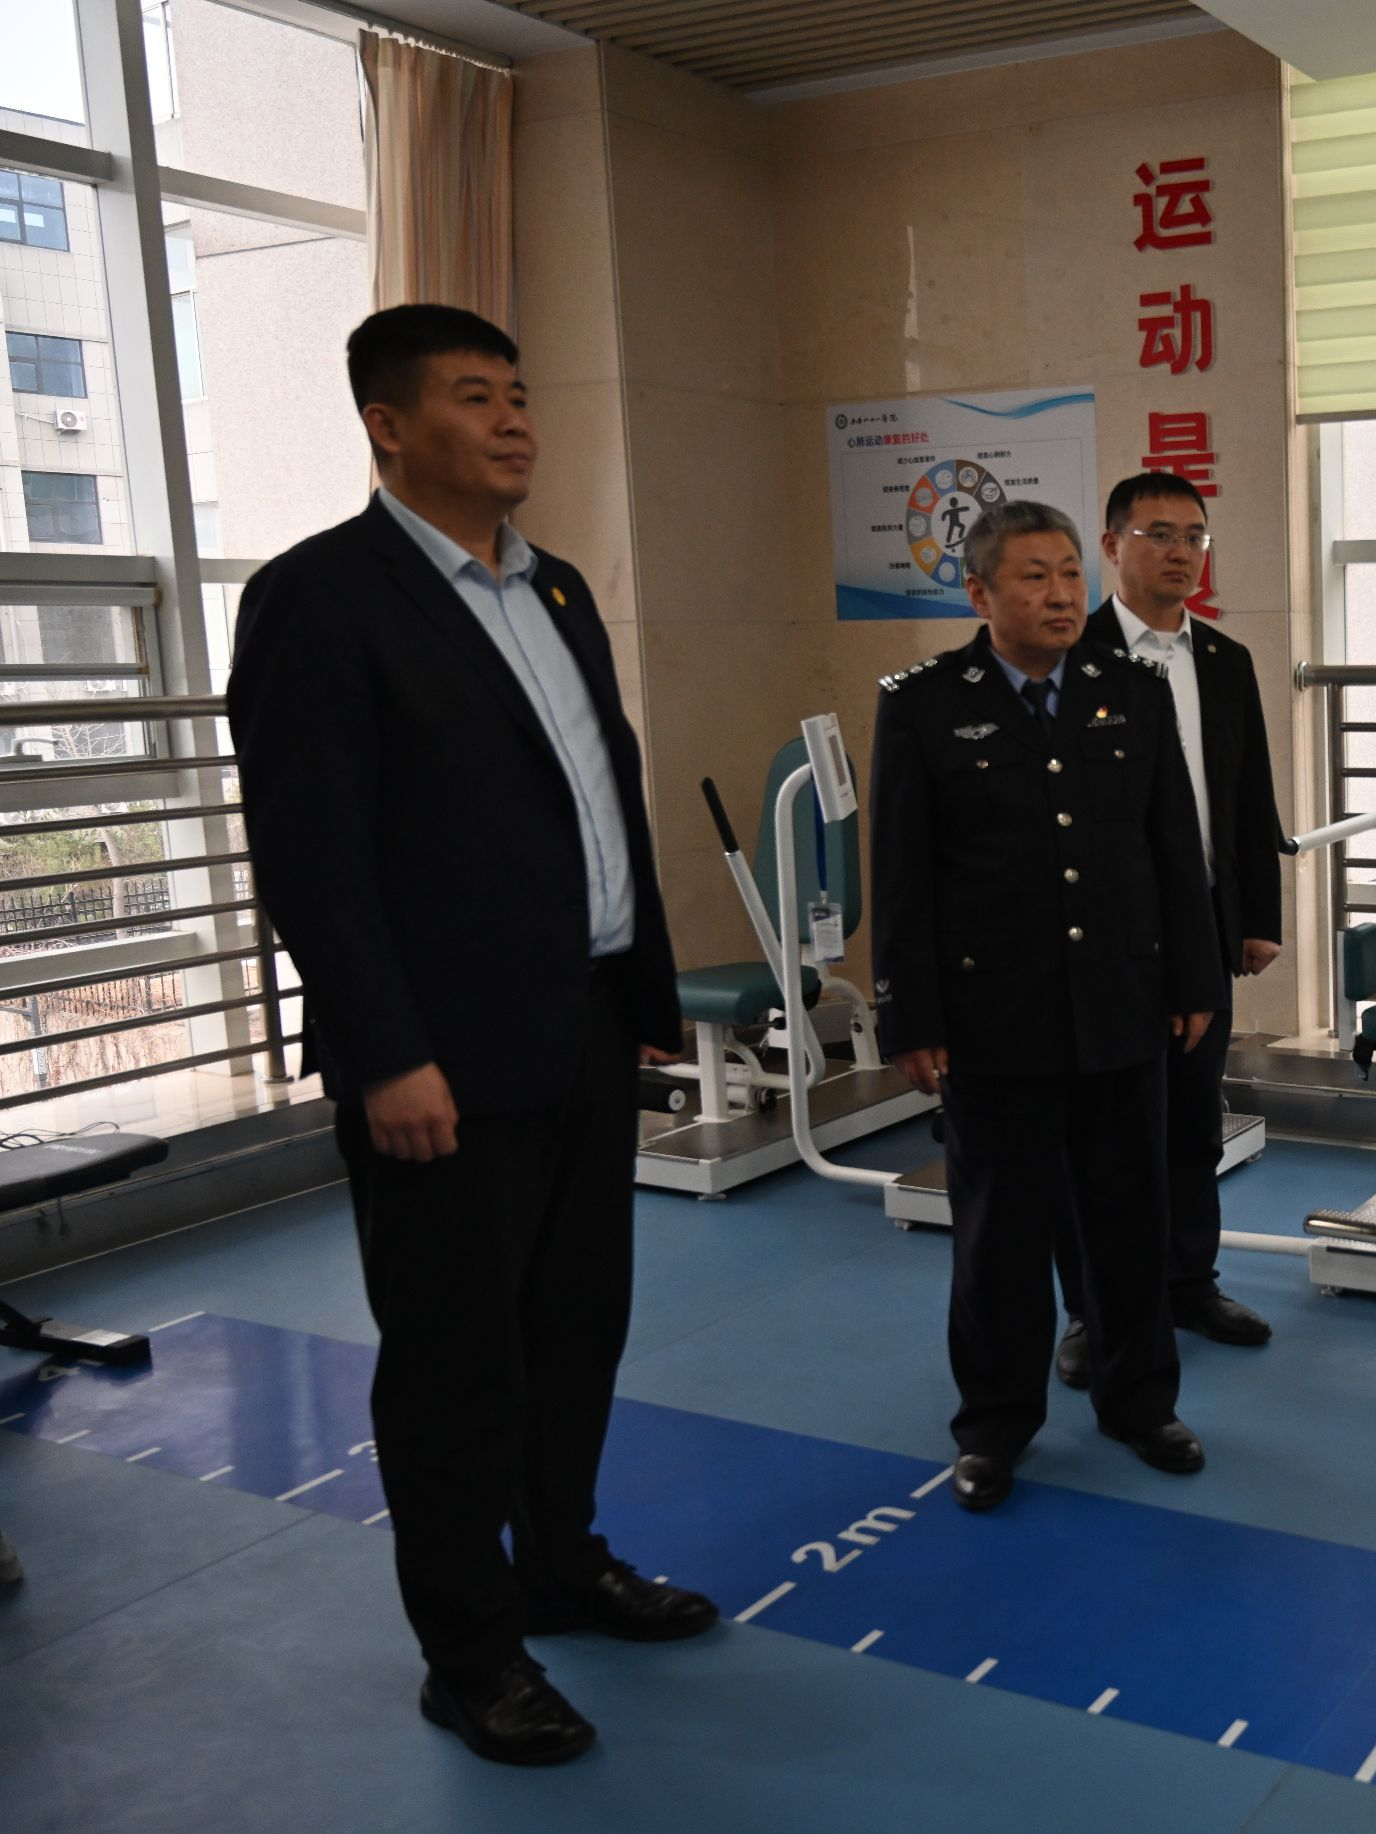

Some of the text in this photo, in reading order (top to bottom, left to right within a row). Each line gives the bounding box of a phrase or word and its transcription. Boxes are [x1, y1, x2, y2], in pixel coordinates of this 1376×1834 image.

[1134, 157, 1221, 620] 运动是
[791, 1506, 917, 1573] 2m
